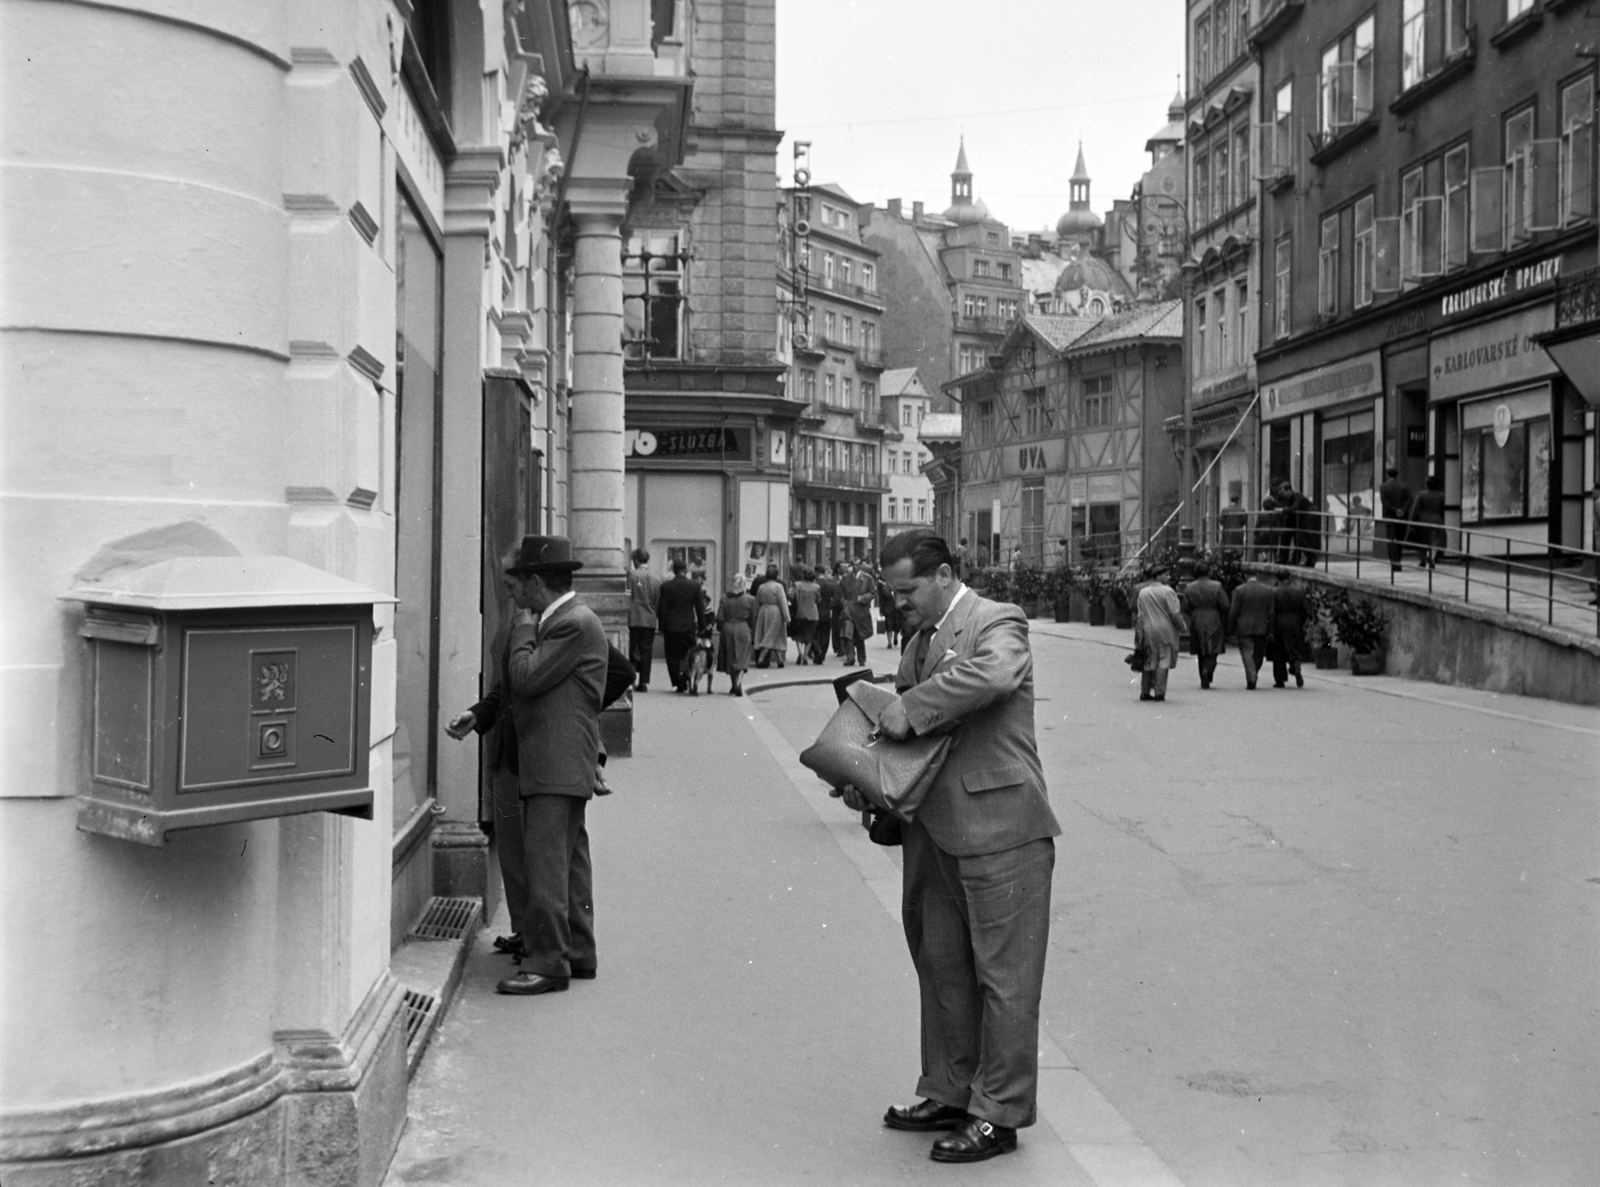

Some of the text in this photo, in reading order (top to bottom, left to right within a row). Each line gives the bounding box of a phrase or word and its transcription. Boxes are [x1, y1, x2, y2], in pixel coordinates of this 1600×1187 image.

[793, 140, 812, 237] FOTO
[1442, 256, 1561, 317] KARLOVARSKÉ OPLATKY
[1444, 334, 1518, 375] KARLOVARSKÉ
[1019, 445, 1047, 471] UVA
